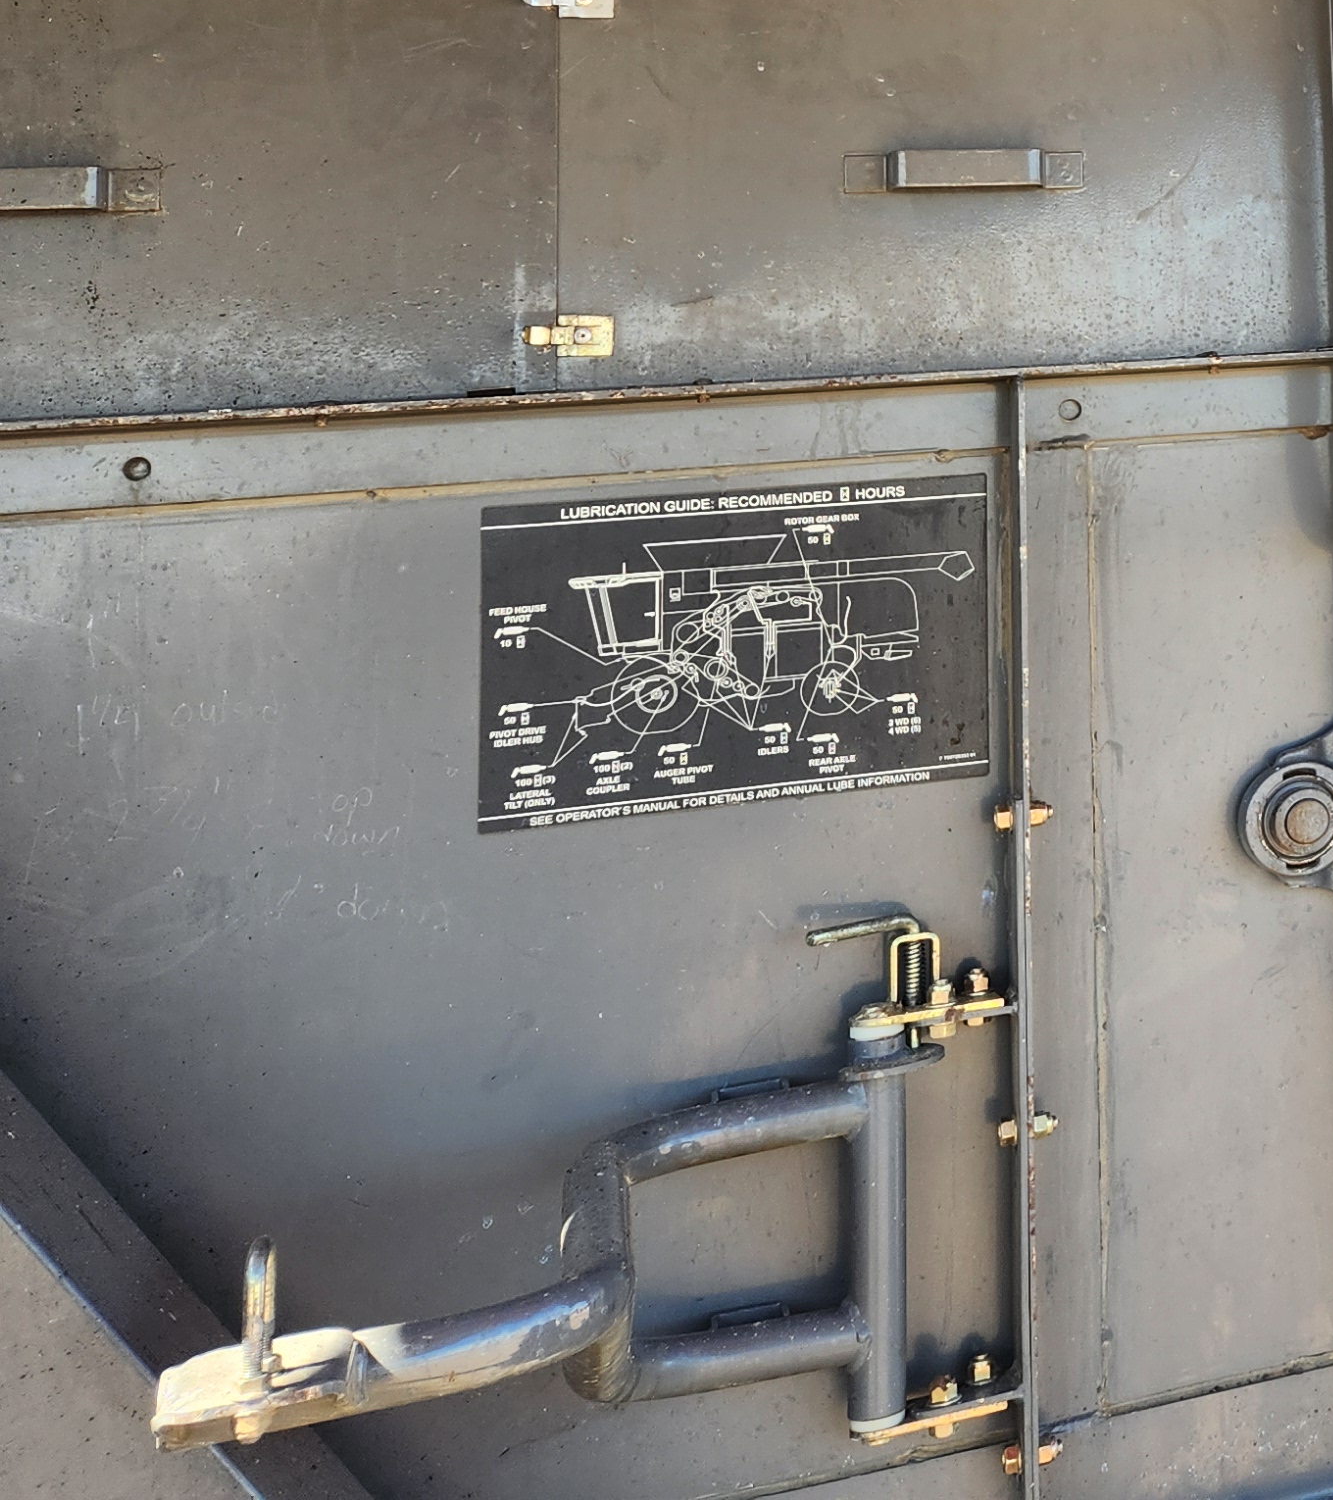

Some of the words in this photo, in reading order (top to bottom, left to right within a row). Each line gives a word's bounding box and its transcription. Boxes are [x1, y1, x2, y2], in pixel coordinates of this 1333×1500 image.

[561, 502, 661, 520] LUBRICATION
[664, 498, 715, 511] GUIDE:
[718, 490, 833, 509] RECOMMENDED
[855, 486, 905, 499] HOURS
[784, 516, 814, 526] ROTOR
[816, 515, 839, 523] GEAR
[841, 513, 859, 521] BOX
[808, 536, 818, 544] 50
[489, 606, 513, 617] FEED
[515, 604, 547, 614] HOUSE
[503, 614, 532, 624] PIVOT
[892, 705, 903, 714] 50
[504, 717, 516, 725] 50
[895, 718, 909, 726] WD
[489, 729, 517, 740] PIVOT
[518, 726, 546, 736] DRIVE
[895, 726, 910, 734] WD
[493, 738, 521, 748] IDLER
[522, 735, 543, 744] HUB
[764, 736, 776, 744] 50
[758, 745, 789, 756] IDLERS
[813, 746, 824, 754] 50
[663, 757, 675, 765] 50
[809, 756, 832, 767] REAR
[833, 754, 856, 764] AXLE
[593, 764, 611, 773] 100
[654, 767, 685, 779] AUGER
[686, 764, 714, 775] PIVOT
[819, 764, 845, 774] PIVOT
[514, 778, 532, 787] 100
[596, 775, 621, 786] AXLE
[672, 774, 696, 785] TUBE
[510, 788, 551, 800] LATERAL
[586, 783, 631, 796] COUPLER
[503, 799, 523, 810] TILT
[524, 797, 555, 809] (ONLY)
[530, 814, 554, 827] SEE
[556, 805, 631, 824] OPERATOR'S
[633, 801, 680, 815] MANUAL
[683, 796, 707, 808] FOR
[709, 789, 754, 805] DETAILS
[756, 787, 780, 799] AND
[781, 782, 825, 796] ANNUAL
[827, 779, 855, 791] LUBE
[858, 771, 930, 788] INFORMATION
